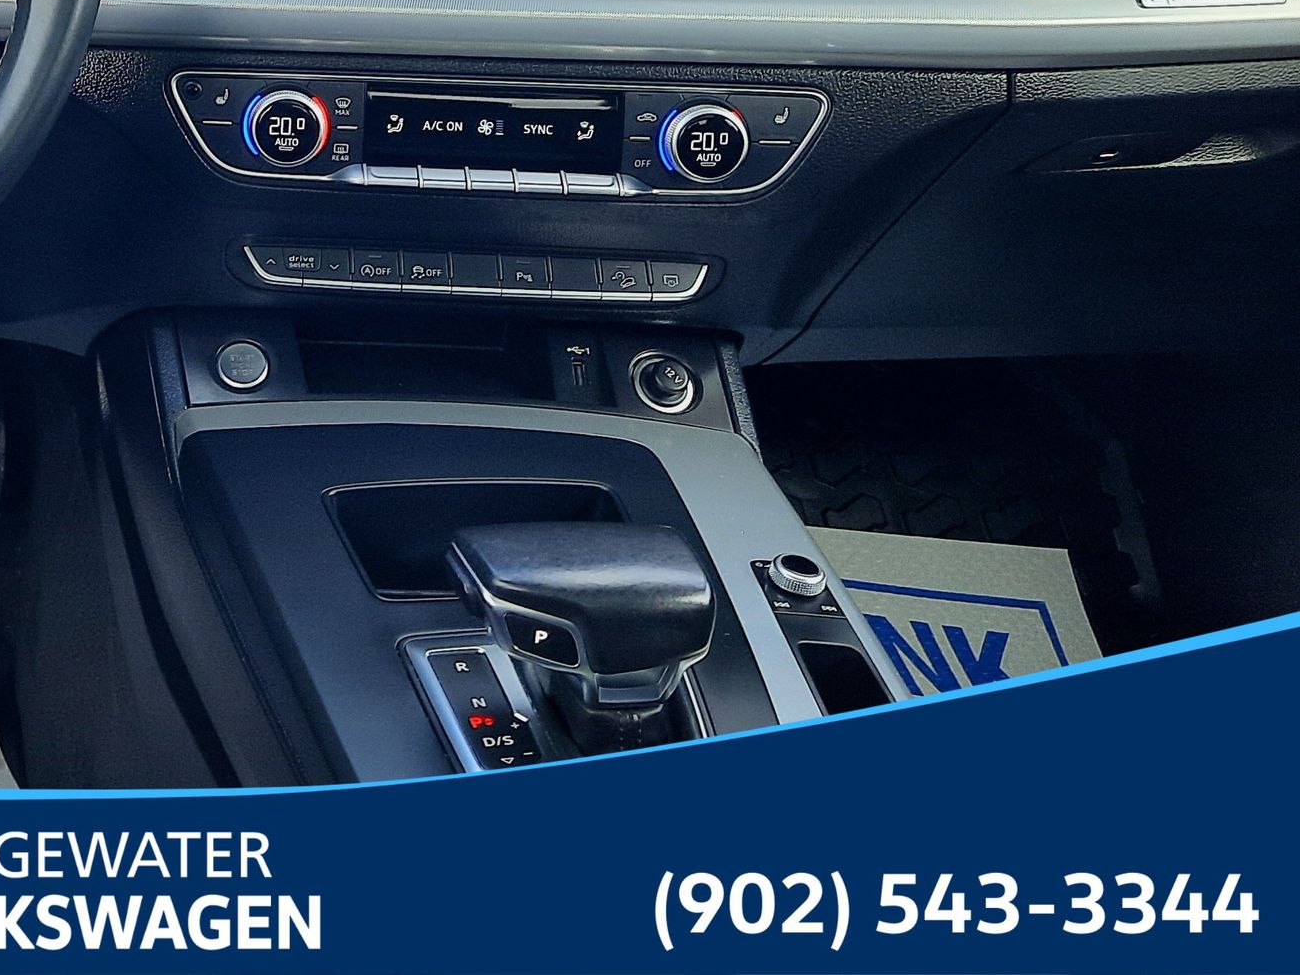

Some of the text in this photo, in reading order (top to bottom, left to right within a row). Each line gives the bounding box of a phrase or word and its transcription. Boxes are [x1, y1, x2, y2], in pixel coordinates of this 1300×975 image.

[423, 120, 463, 131] A/C ON
[523, 124, 553, 135] SYNC
[275, 138, 299, 146] AUTO
[696, 154, 722, 162] AUTO
[634, 159, 652, 168] OFF
[375, 267, 392, 276] OFF
[426, 268, 442, 277] OFF
[534, 630, 548, 644] P
[455, 662, 469, 672] R
[471, 697, 487, 708] N
[482, 735, 515, 747] D/S
